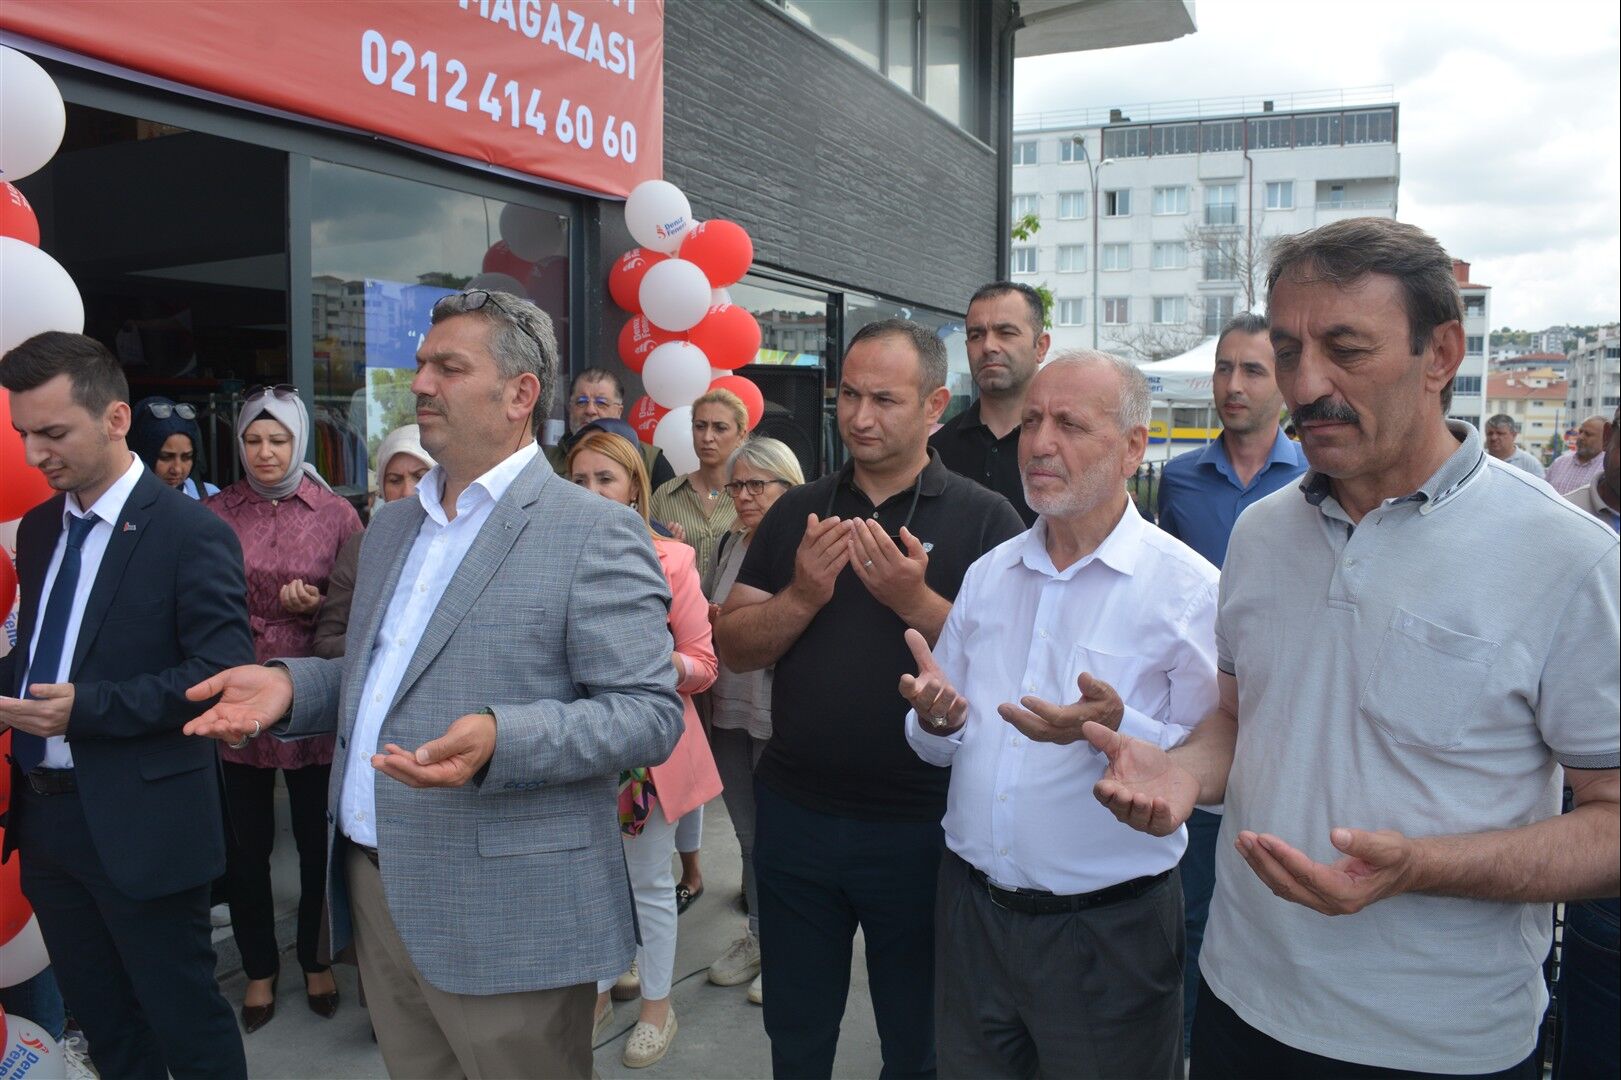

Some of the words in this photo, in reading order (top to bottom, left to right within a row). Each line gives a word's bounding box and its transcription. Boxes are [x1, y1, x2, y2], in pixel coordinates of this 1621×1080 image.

[361, 29, 468, 112] 0212
[479, 72, 546, 136] 414
[555, 98, 593, 150] 60
[602, 115, 637, 163] 60
